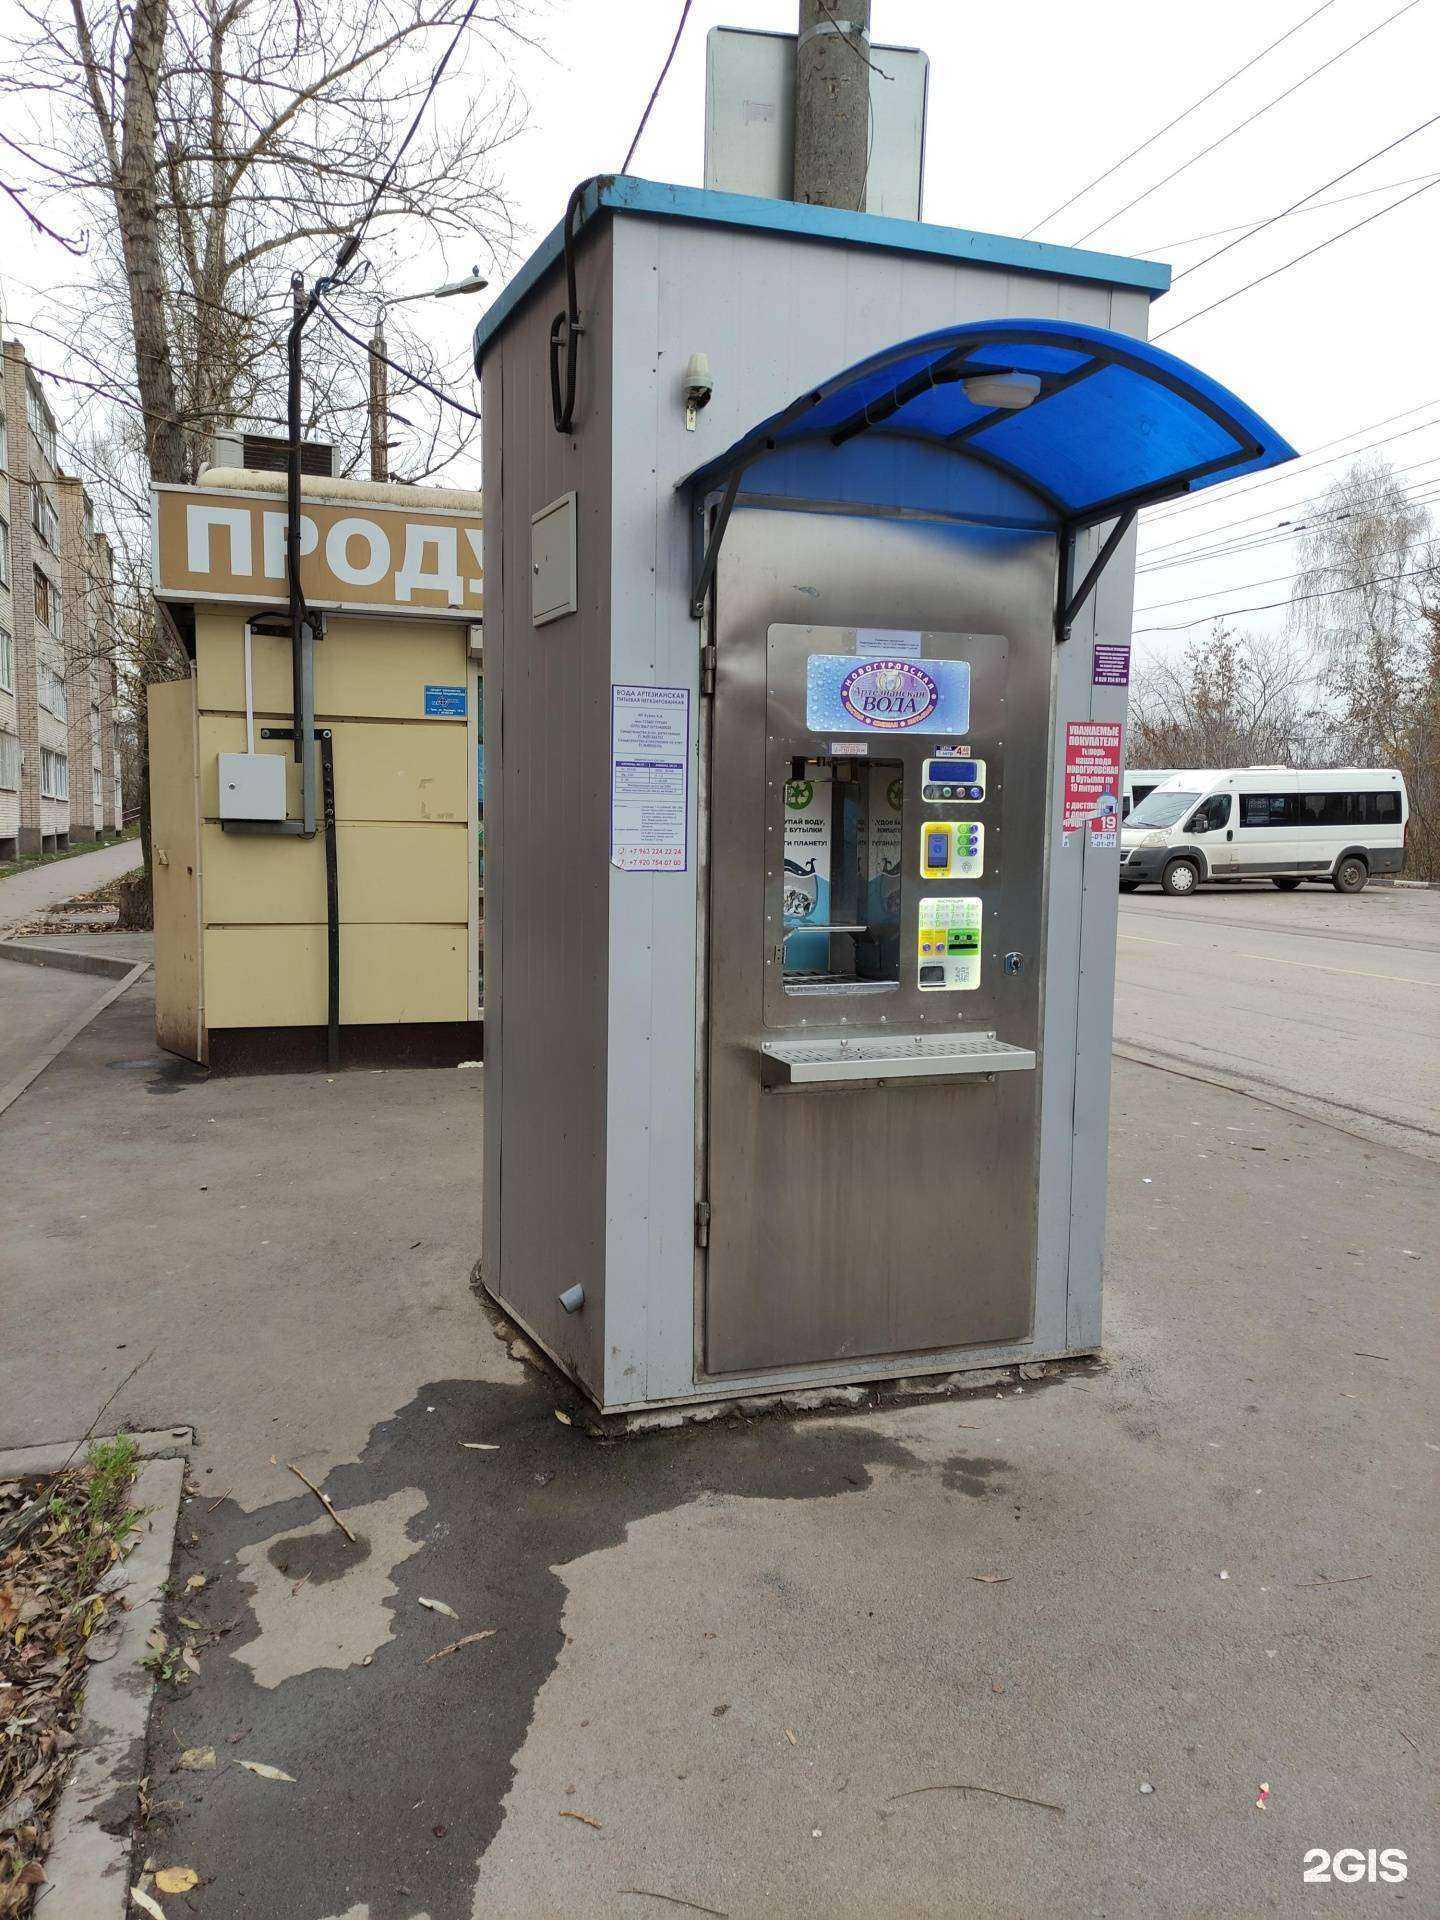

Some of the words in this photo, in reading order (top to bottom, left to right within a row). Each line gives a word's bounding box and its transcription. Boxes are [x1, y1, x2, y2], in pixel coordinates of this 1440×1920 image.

[844, 662, 935, 690] НОВОГУРОВСКАЯ
[616, 689, 636, 697] ВОДА
[637, 690, 685, 699] АРТЕЗИАНСКАЯ
[863, 696, 917, 713] ВОДА
[1069, 725, 1119, 737] УВАЖАЕМЫЕ
[1069, 735, 1119, 746] ПОКУПАТЕЛИ
[1066, 765, 1119, 775] НОВОГУРОВСКАЯ
[1071, 783, 1078, 792] 19
[1100, 816, 1117, 829] 19
